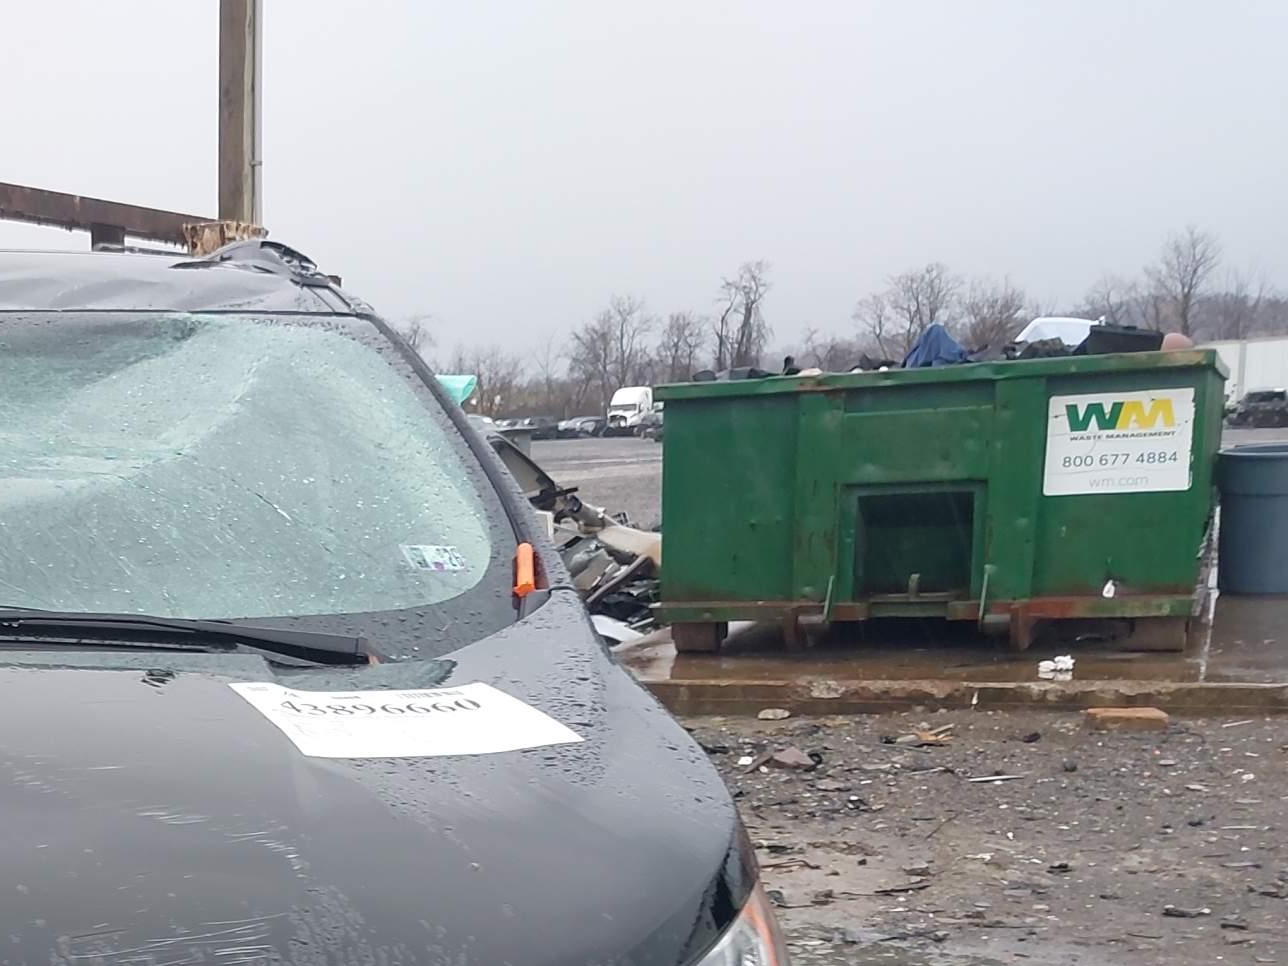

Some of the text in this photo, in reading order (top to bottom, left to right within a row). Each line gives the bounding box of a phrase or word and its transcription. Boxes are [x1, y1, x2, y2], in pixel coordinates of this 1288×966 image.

[1065, 398, 1177, 432] WM
[1106, 431, 1177, 439] MANAGEMENT
[1062, 451, 1179, 468] 800 677 4884
[1089, 475, 1149, 488] wm.com
[280, 698, 482, 715] 43896660
